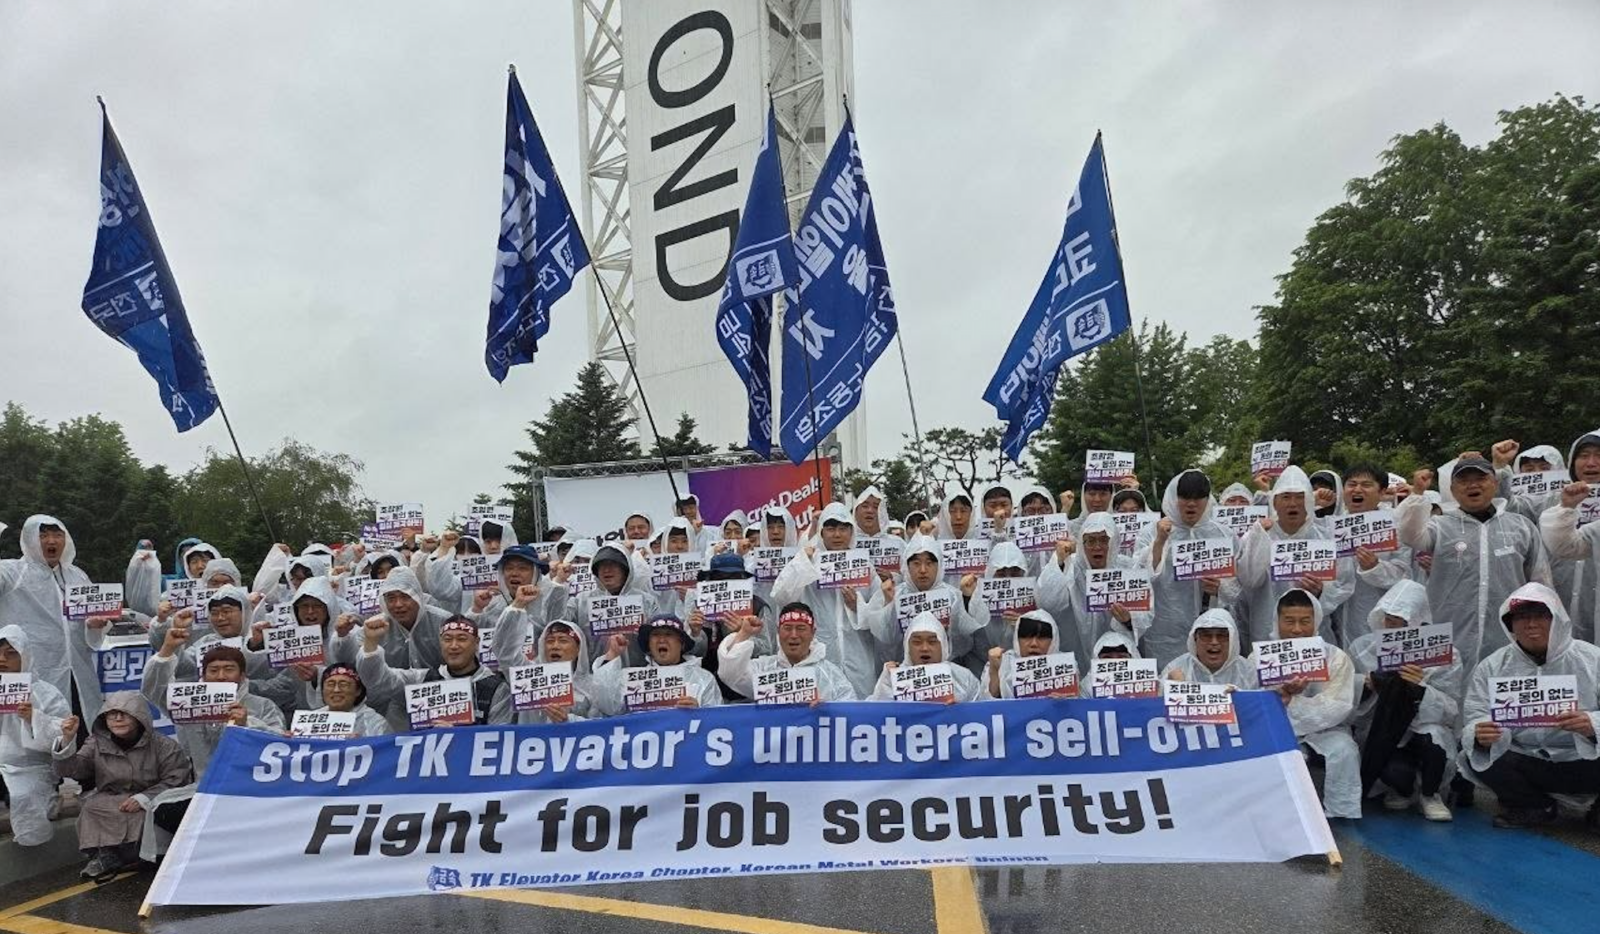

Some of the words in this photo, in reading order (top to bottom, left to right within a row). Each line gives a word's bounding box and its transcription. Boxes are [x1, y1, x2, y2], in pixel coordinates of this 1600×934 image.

[1334, 514, 1364, 530] 조합원
[1351, 523, 1369, 536] 동의
[1372, 519, 1392, 531] 없는
[1372, 530, 1393, 544] 아웃!
[1177, 541, 1206, 554] 조합원
[1193, 550, 1210, 561] 동의
[1213, 547, 1231, 558] 없는
[1277, 541, 1307, 553] 조합원
[1293, 551, 1311, 561] 동의
[1314, 549, 1334, 559] 없는
[1212, 557, 1232, 570] 아웃!
[1312, 560, 1335, 572] 아웃!
[1092, 571, 1122, 583] 조합원
[701, 582, 728, 594] 조합원
[1108, 580, 1125, 591] 동의
[1129, 579, 1148, 589] 없는
[716, 591, 731, 602] 동의
[734, 589, 750, 599] 없는
[1127, 590, 1148, 602] 아웃!
[732, 600, 750, 611] 아웃!
[1383, 628, 1418, 643] 조합원
[1403, 638, 1423, 650] 동의
[1428, 634, 1450, 646] 없는
[1260, 641, 1293, 656] 조합원
[1279, 651, 1299, 663] 동의
[1302, 647, 1323, 659] 없는
[1426, 645, 1451, 659] 아웃!
[1017, 657, 1046, 672] 조합원
[1034, 667, 1051, 680] 동의
[1054, 663, 1074, 676] 없는
[1097, 661, 1128, 673] 조합원
[1302, 659, 1325, 673] 아웃!
[515, 666, 544, 681] 조합원
[531, 676, 548, 688] 동의
[551, 672, 569, 685] 없는
[628, 668, 657, 682] 조합원
[1114, 671, 1132, 682] 동의
[1136, 669, 1155, 680] 없는
[645, 679, 662, 690] 동의
[665, 676, 682, 687] 없는
[1054, 675, 1076, 690] 아웃!
[1135, 681, 1156, 693] 아웃!
[1169, 684, 1201, 694] 조합원
[1495, 678, 1538, 693] 조합원
[411, 684, 441, 700] 조합원
[550, 684, 570, 698] 아웃!
[1520, 690, 1544, 703] 동의
[1549, 688, 1574, 701] 없는
[428, 694, 446, 707] 동의
[449, 690, 468, 703] 없는
[1187, 694, 1206, 703] 동의
[1209, 694, 1228, 703] 없는
[448, 702, 469, 716] 아웃!
[1208, 705, 1230, 715] 아웃!
[252, 739, 374, 786] Stop
[394, 733, 448, 778] TK
[469, 718, 734, 777] Elevator's
[752, 714, 1005, 764] unilateral
[305, 798, 507, 857] Fight
[538, 797, 648, 853] for
[676, 791, 789, 850] job
[822, 777, 1175, 845] security!
[470, 872, 494, 888] TK
[499, 871, 580, 887] Elevator
[586, 870, 644, 882] Korea
